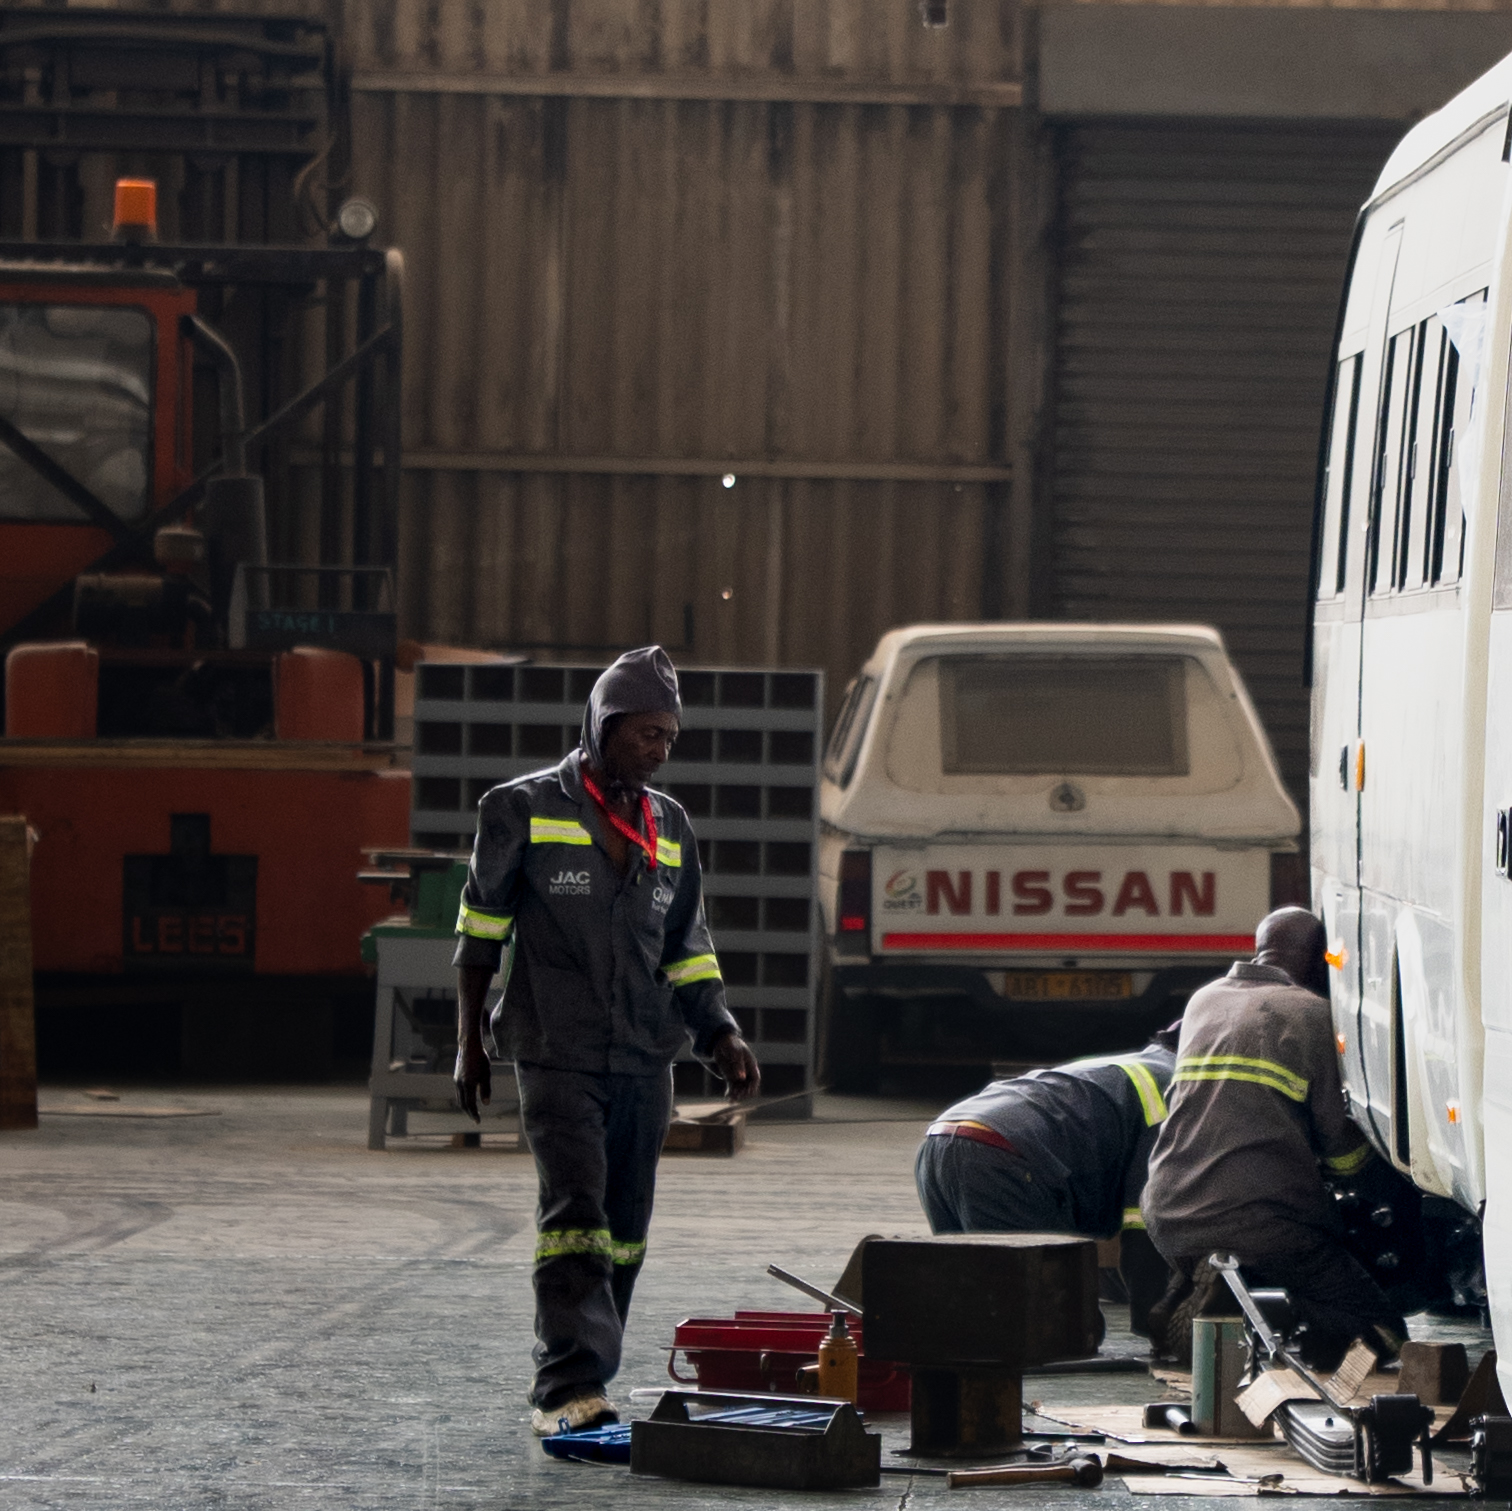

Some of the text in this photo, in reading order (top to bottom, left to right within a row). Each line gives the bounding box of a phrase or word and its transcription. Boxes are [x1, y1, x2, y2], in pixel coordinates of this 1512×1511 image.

[257, 612, 320, 633] STAGE
[550, 871, 590, 884] JAC
[549, 885, 591, 895] MOTORS
[925, 870, 1217, 917] NISSAN
[132, 915, 247, 954] LEES
